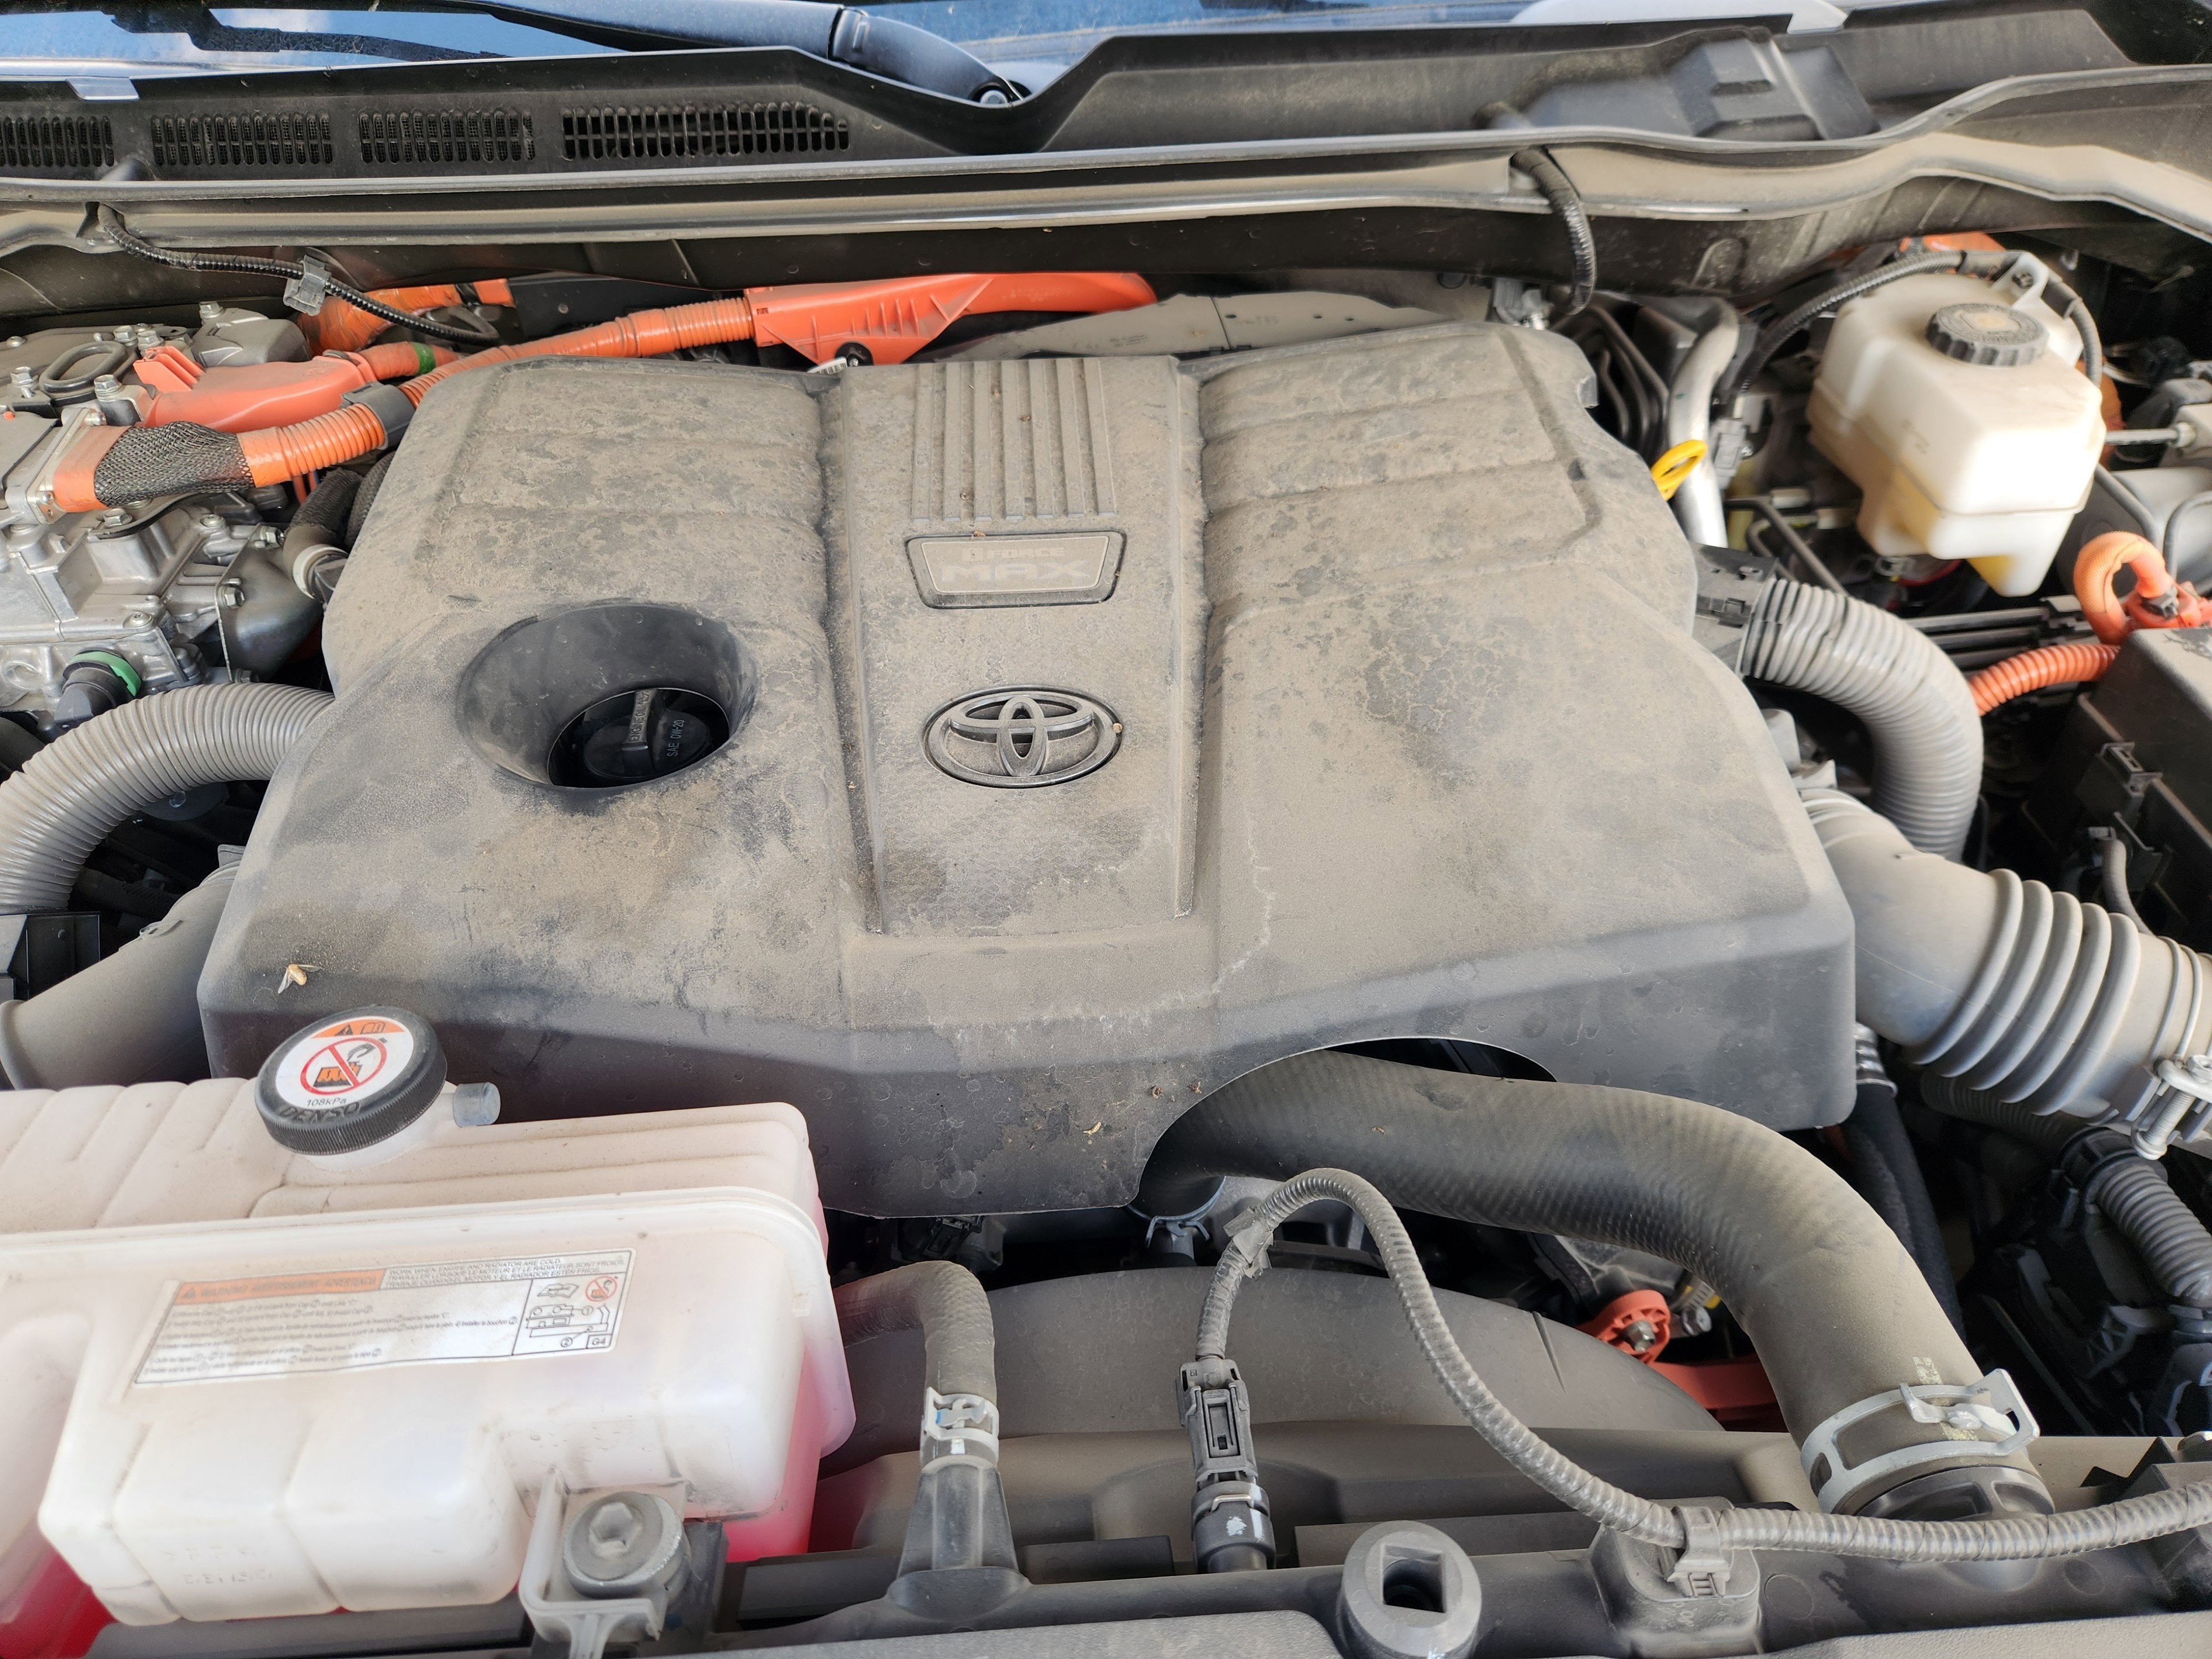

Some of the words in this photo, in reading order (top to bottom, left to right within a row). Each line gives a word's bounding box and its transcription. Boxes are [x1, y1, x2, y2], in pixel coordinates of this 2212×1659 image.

[670, 719, 685, 739] 0W-20
[667, 743, 680, 757] SAE
[307, 1097, 347, 1107] 108kPa
[592, 1337, 606, 1346] G4
